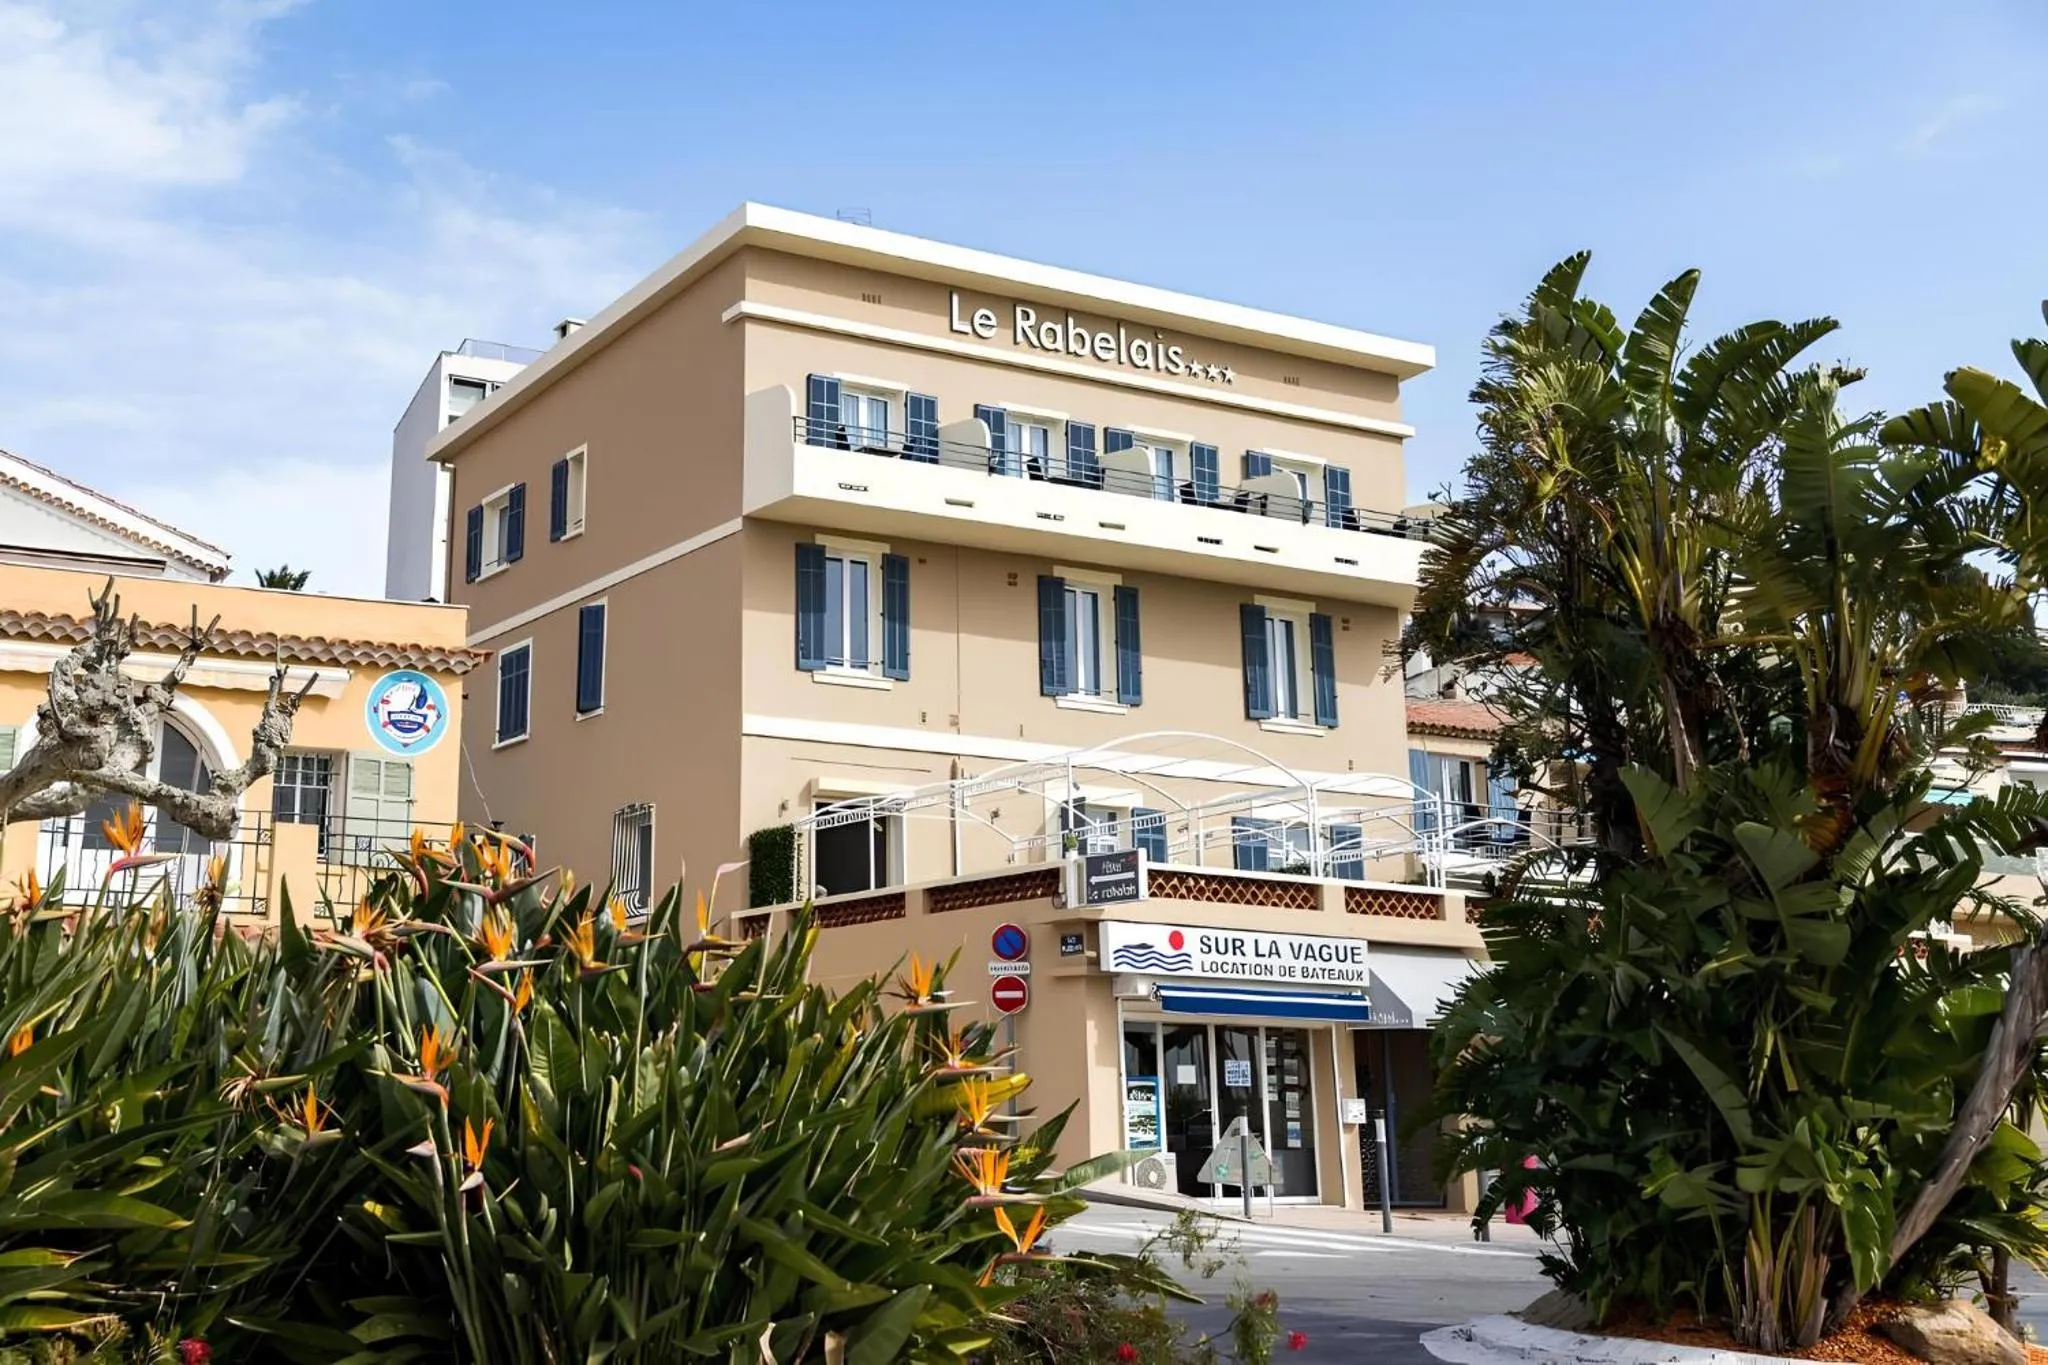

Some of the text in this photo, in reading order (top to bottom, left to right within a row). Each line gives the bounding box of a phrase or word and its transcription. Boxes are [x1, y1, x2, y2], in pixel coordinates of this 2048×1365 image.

[950, 289, 1185, 374] Le Rabelais
[1199, 934, 1364, 964] SUR LA VAGUE
[1201, 960, 1365, 982] LOCATION DE BATEAUX
